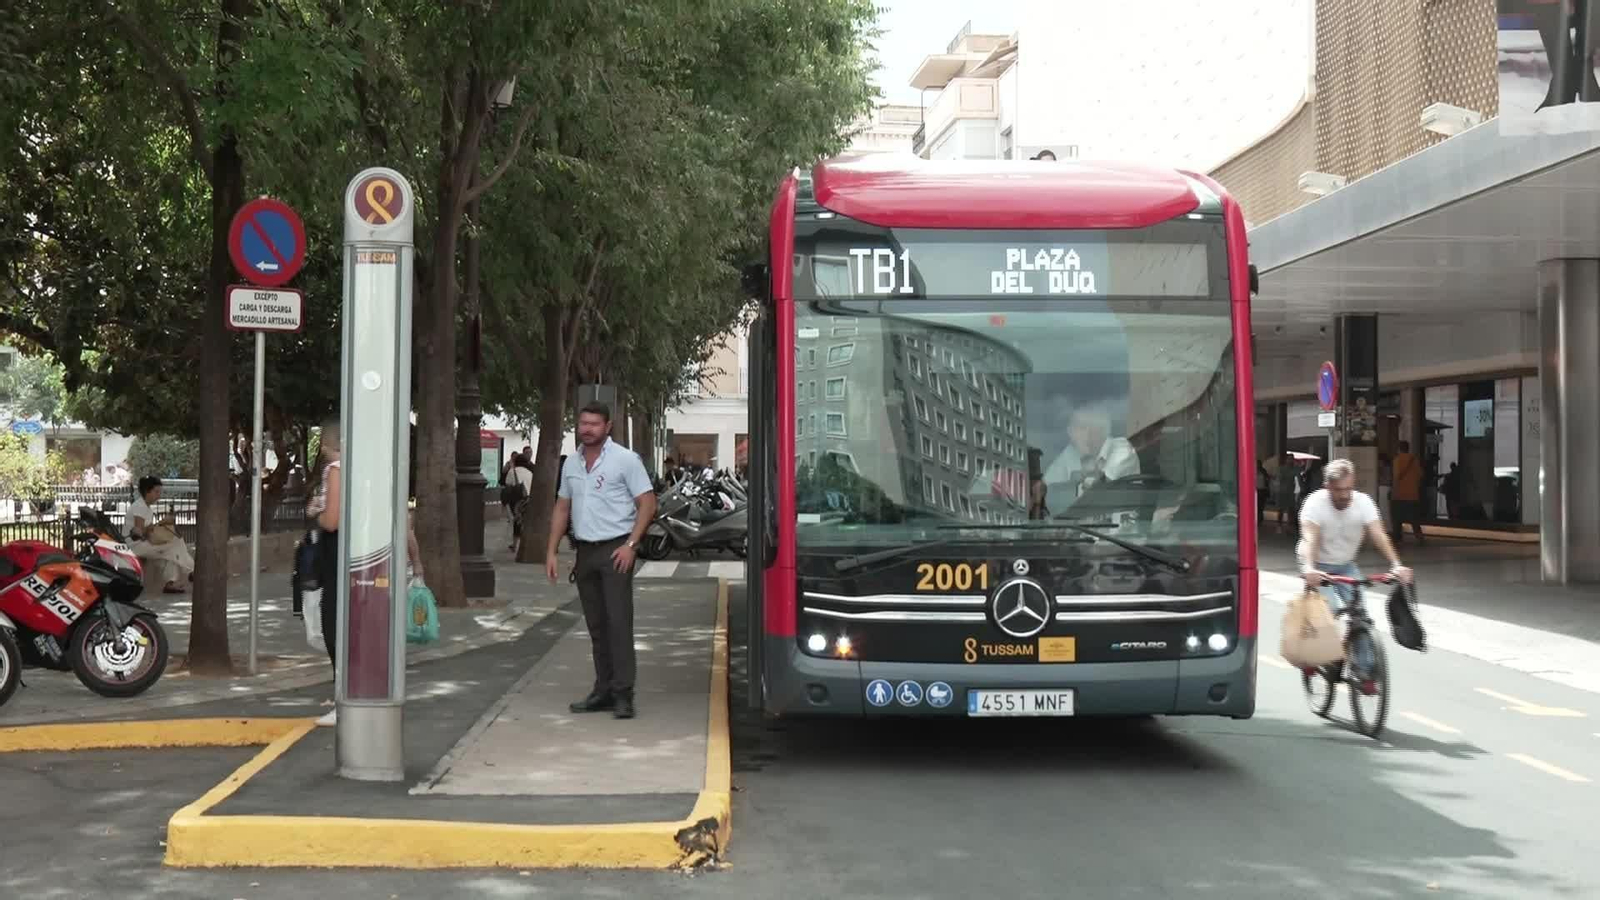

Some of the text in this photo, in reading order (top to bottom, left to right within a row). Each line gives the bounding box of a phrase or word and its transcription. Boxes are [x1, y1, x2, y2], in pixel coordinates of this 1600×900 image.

[1006, 248, 1081, 270] PLAZA
[849, 248, 914, 293] TB1
[991, 271, 1098, 294] DEL DUQ
[254, 292, 278, 301] EXCEPTO
[239, 303, 257, 312] CARGA
[263, 304, 292, 314] DESCARGA
[232, 315, 298, 326] MERCADILLO ARTESANAL
[916, 563, 988, 590] 2001
[981, 644, 1034, 656] TUSSAM
[981, 694, 1068, 711] 4551 MNF
